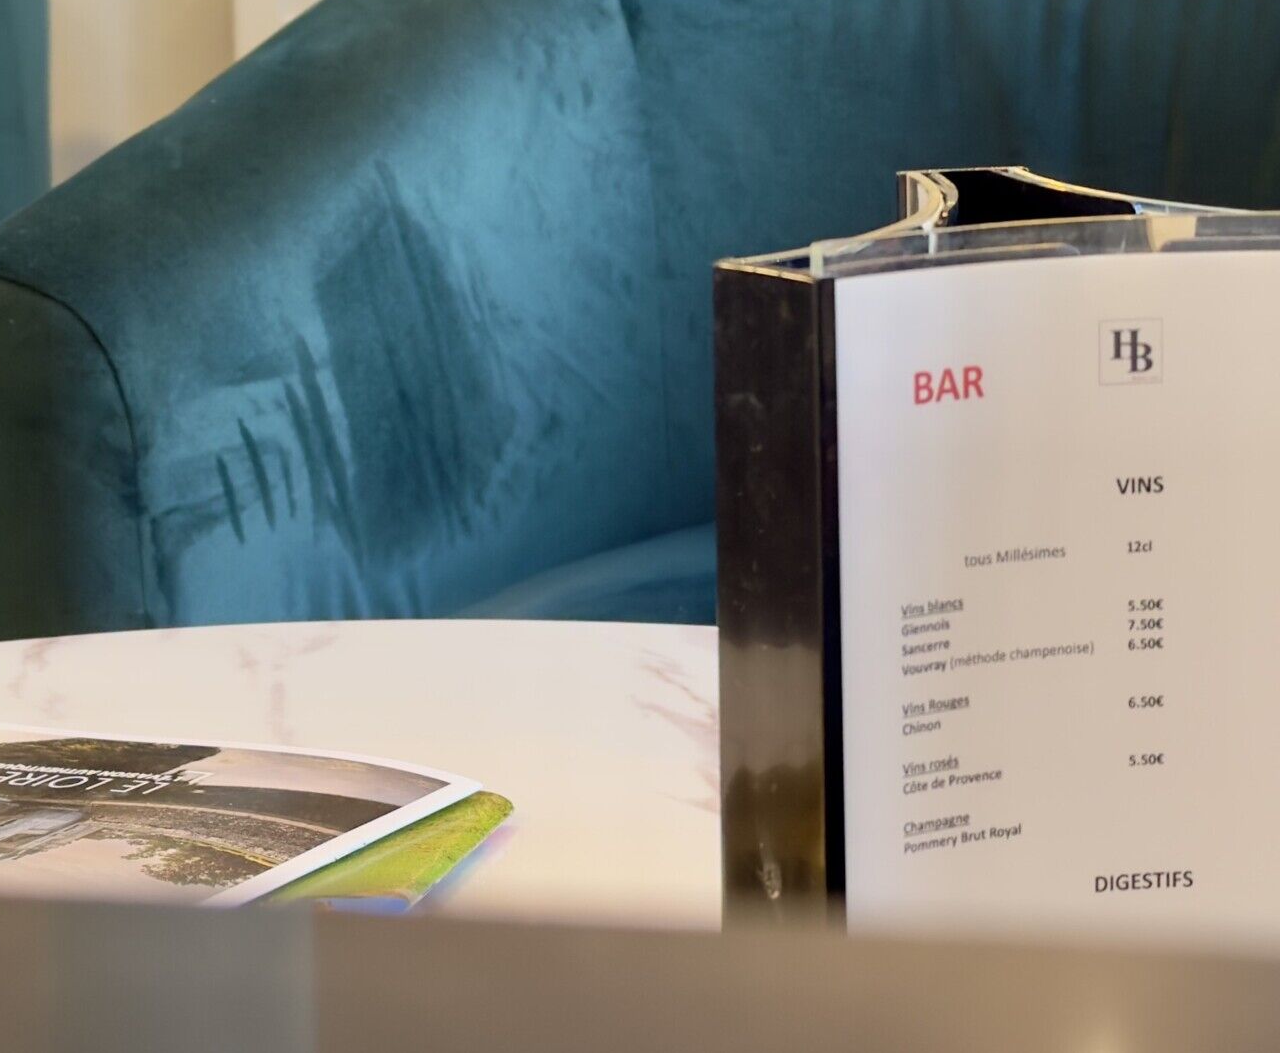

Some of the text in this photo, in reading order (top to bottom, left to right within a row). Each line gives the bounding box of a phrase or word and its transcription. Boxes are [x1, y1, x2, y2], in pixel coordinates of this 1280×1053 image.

[913, 366, 984, 405] BAR
[1116, 476, 1164, 495] VINS
[1127, 541, 1152, 554] 12cl
[964, 547, 1066, 568] tous Millésimes
[901, 598, 963, 618] Vins blancs
[1127, 599, 1163, 612] 5.50€
[1127, 618, 1163, 631] 7.50€
[902, 640, 950, 656] Sancerre
[1127, 637, 1163, 651] 6.50€
[901, 640, 1095, 676] Vouvray (méthode champenoise)
[902, 696, 970, 717] Vins Rouges
[1128, 695, 1164, 708] 6.50€
[902, 721, 941, 735] Chinon
[902, 755, 959, 777] Vins rosés
[1128, 753, 1164, 767] 5.50€
[110, 779, 170, 795] LE
[903, 769, 1002, 795] Côte de Provence
[904, 813, 970, 835] Champagne
[904, 823, 1022, 854] Pommery Brut Royal
[1095, 870, 1194, 893] DIGESTIFS
